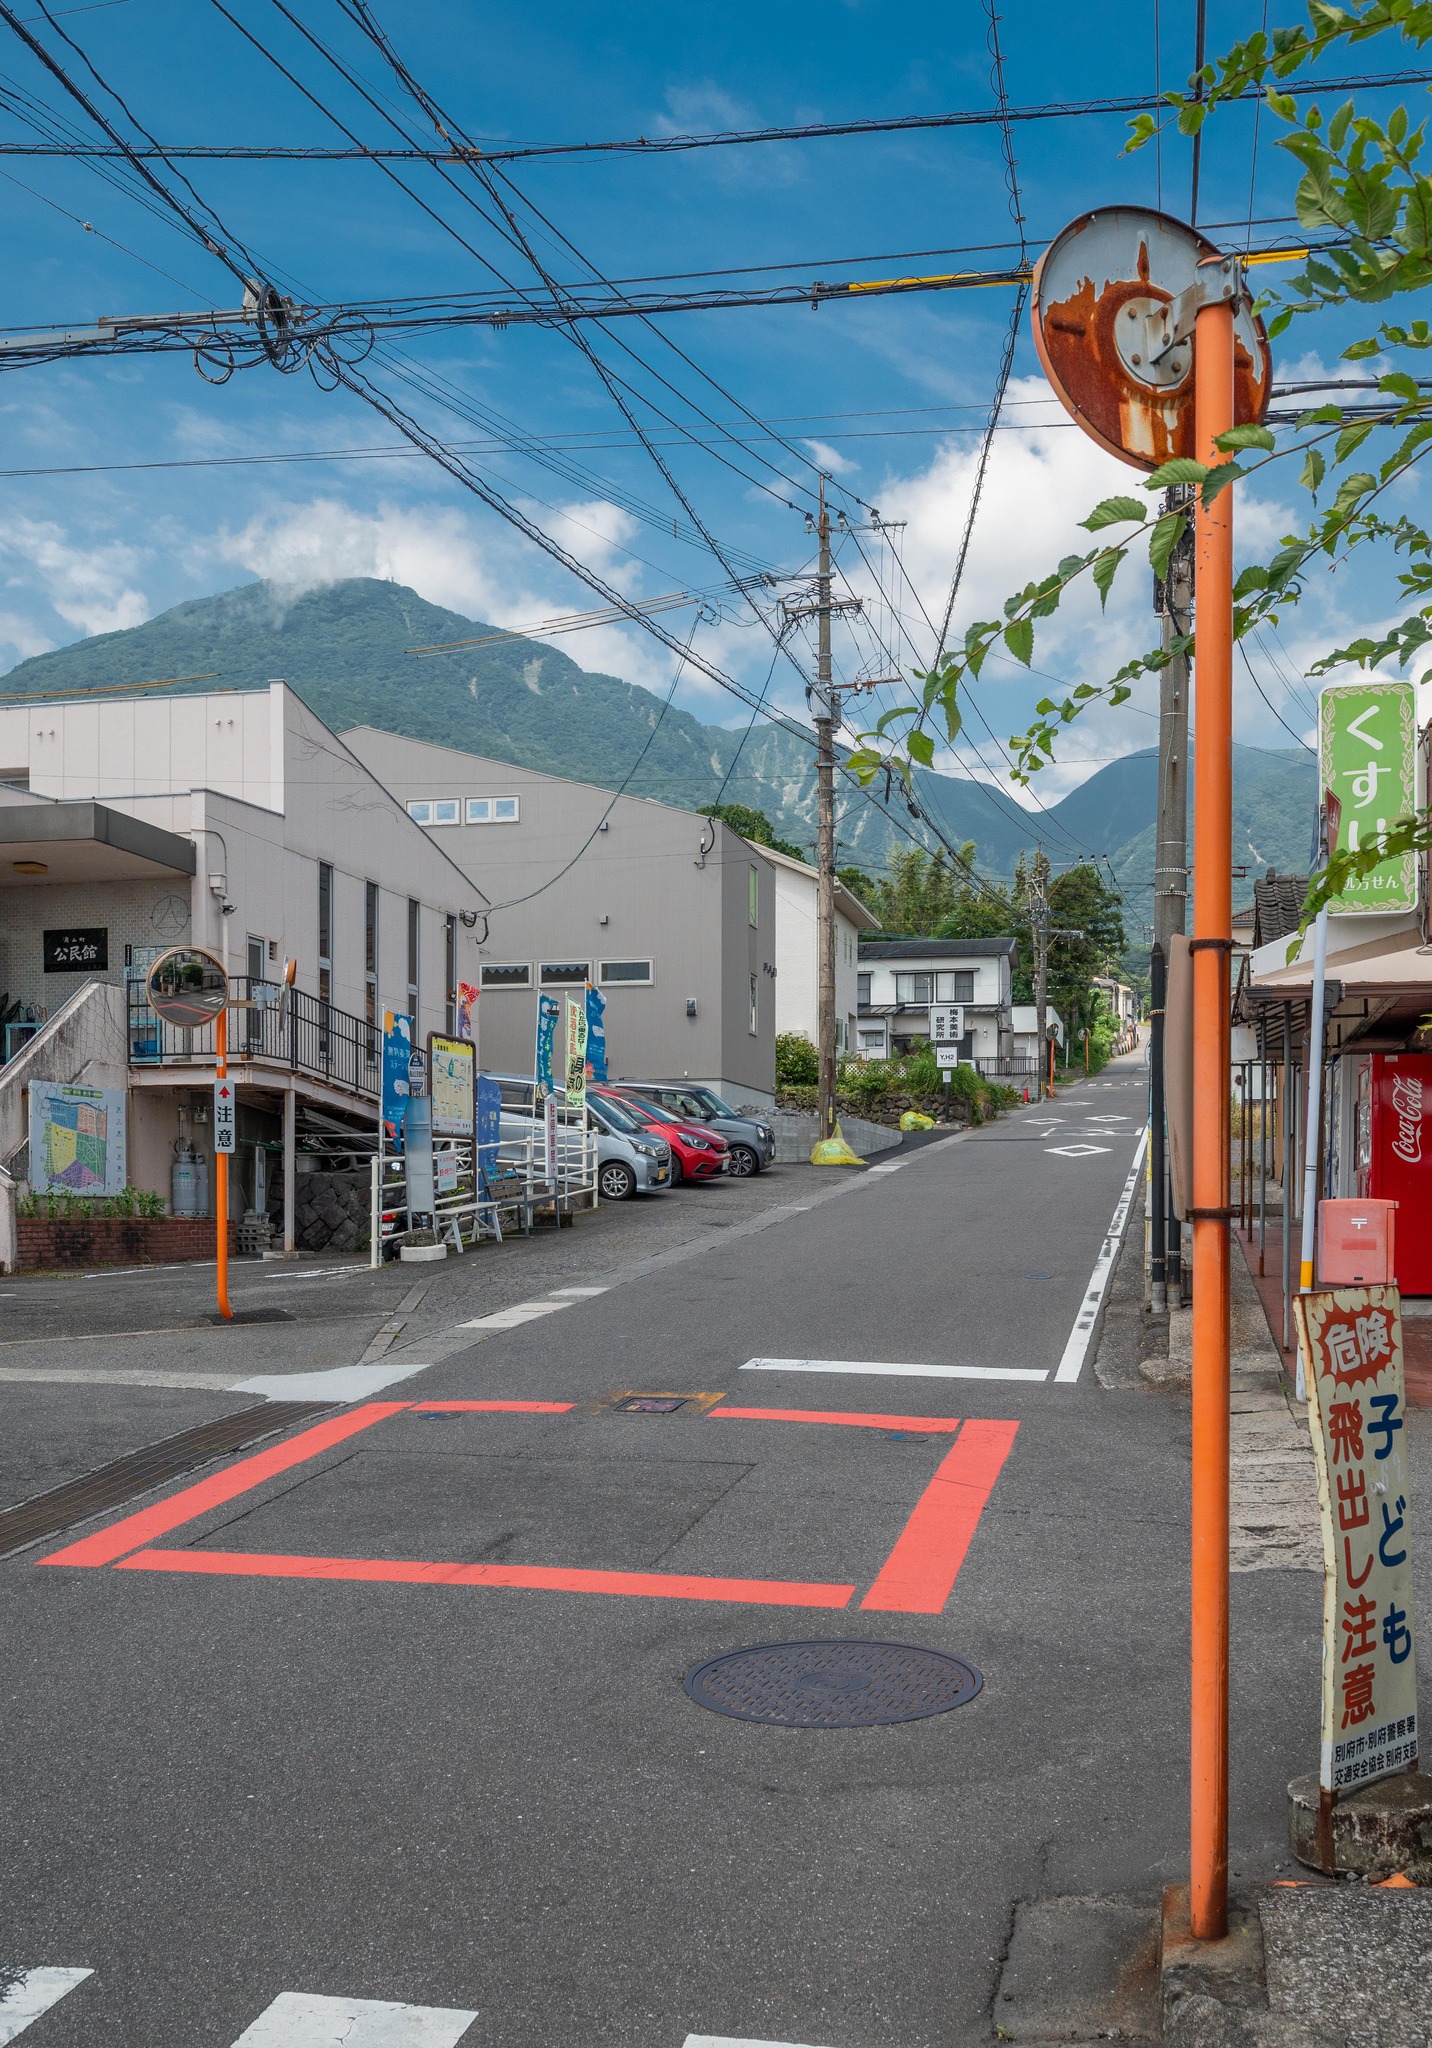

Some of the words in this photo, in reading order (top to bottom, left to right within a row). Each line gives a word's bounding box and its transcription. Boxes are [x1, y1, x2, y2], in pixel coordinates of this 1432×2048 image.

[1342, 704, 1392, 854] くすり
[1343, 875, 1400, 893] 処方せん
[53, 944, 98, 962] 公民館
[936, 1016, 945, 1038] 研究所
[216, 1105, 233, 1149] 注意
[1391, 1072, 1422, 1163] Coca-Cola
[1324, 1310, 1390, 1375] 危険
[1367, 1393, 1411, 1664] 子ども
[1328, 1398, 1377, 1730] 飛出し注意
[1334, 1752, 1385, 1788] 交通安全協会
[1386, 1739, 1417, 1768] 別府支部
